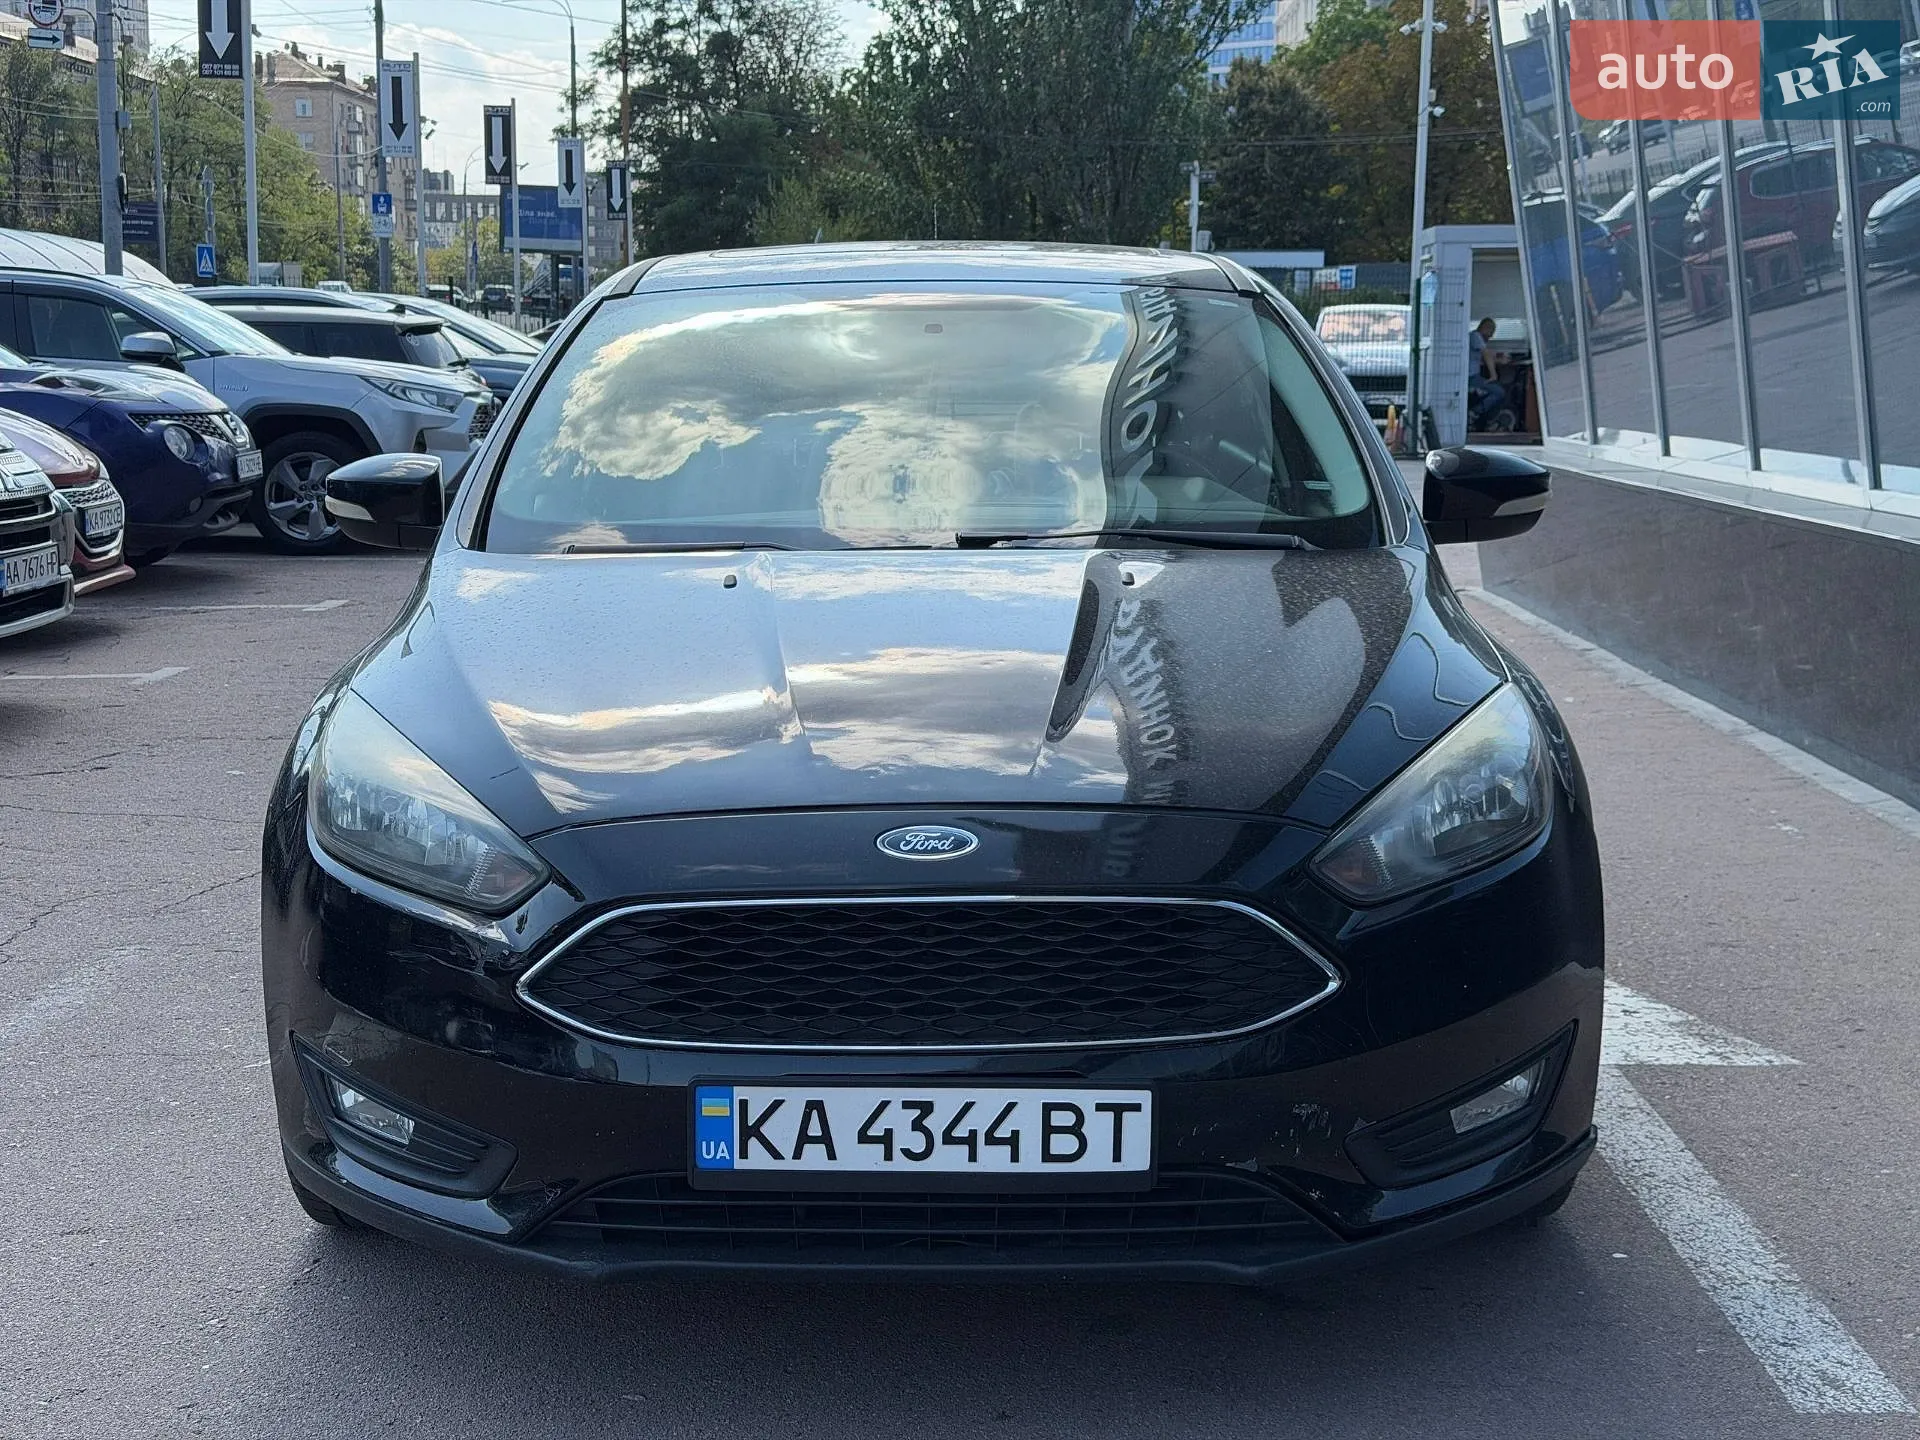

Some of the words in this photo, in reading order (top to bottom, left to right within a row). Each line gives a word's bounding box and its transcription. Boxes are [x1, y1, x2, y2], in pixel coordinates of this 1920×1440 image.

[6, 561, 20, 586] AA
[22, 553, 45, 582] 7676
[46, 551, 58, 576] HP
[899, 832, 955, 851] Ford
[738, 1098, 837, 1161] KA
[857, 1099, 1020, 1163] 4344
[1041, 1101, 1143, 1164] BT
[702, 1141, 730, 1160] UA
